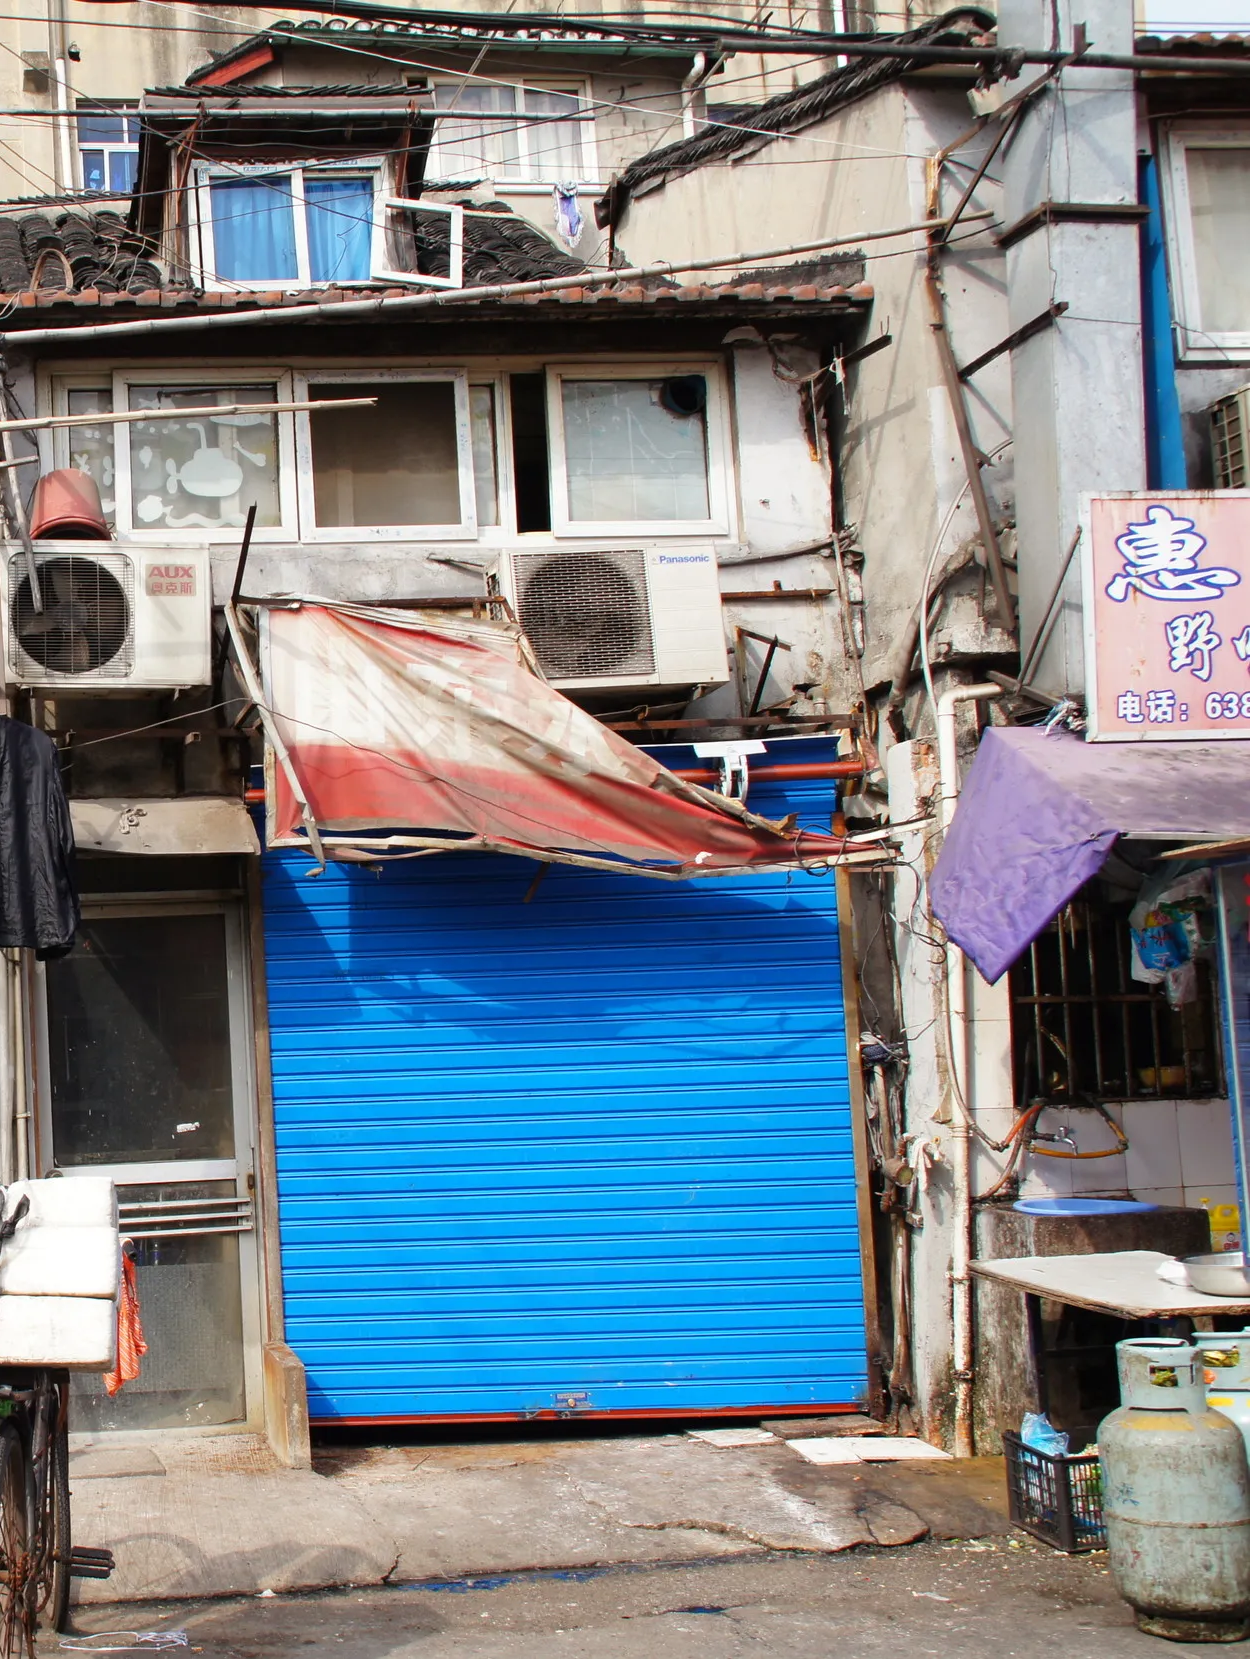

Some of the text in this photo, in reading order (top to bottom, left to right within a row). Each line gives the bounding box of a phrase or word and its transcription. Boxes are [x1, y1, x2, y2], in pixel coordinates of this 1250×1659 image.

[659, 554, 710, 564] Panasonic
[1105, 504, 1242, 603] 惠
[149, 566, 193, 578] AUX
[151, 581, 193, 595] 奥克斯
